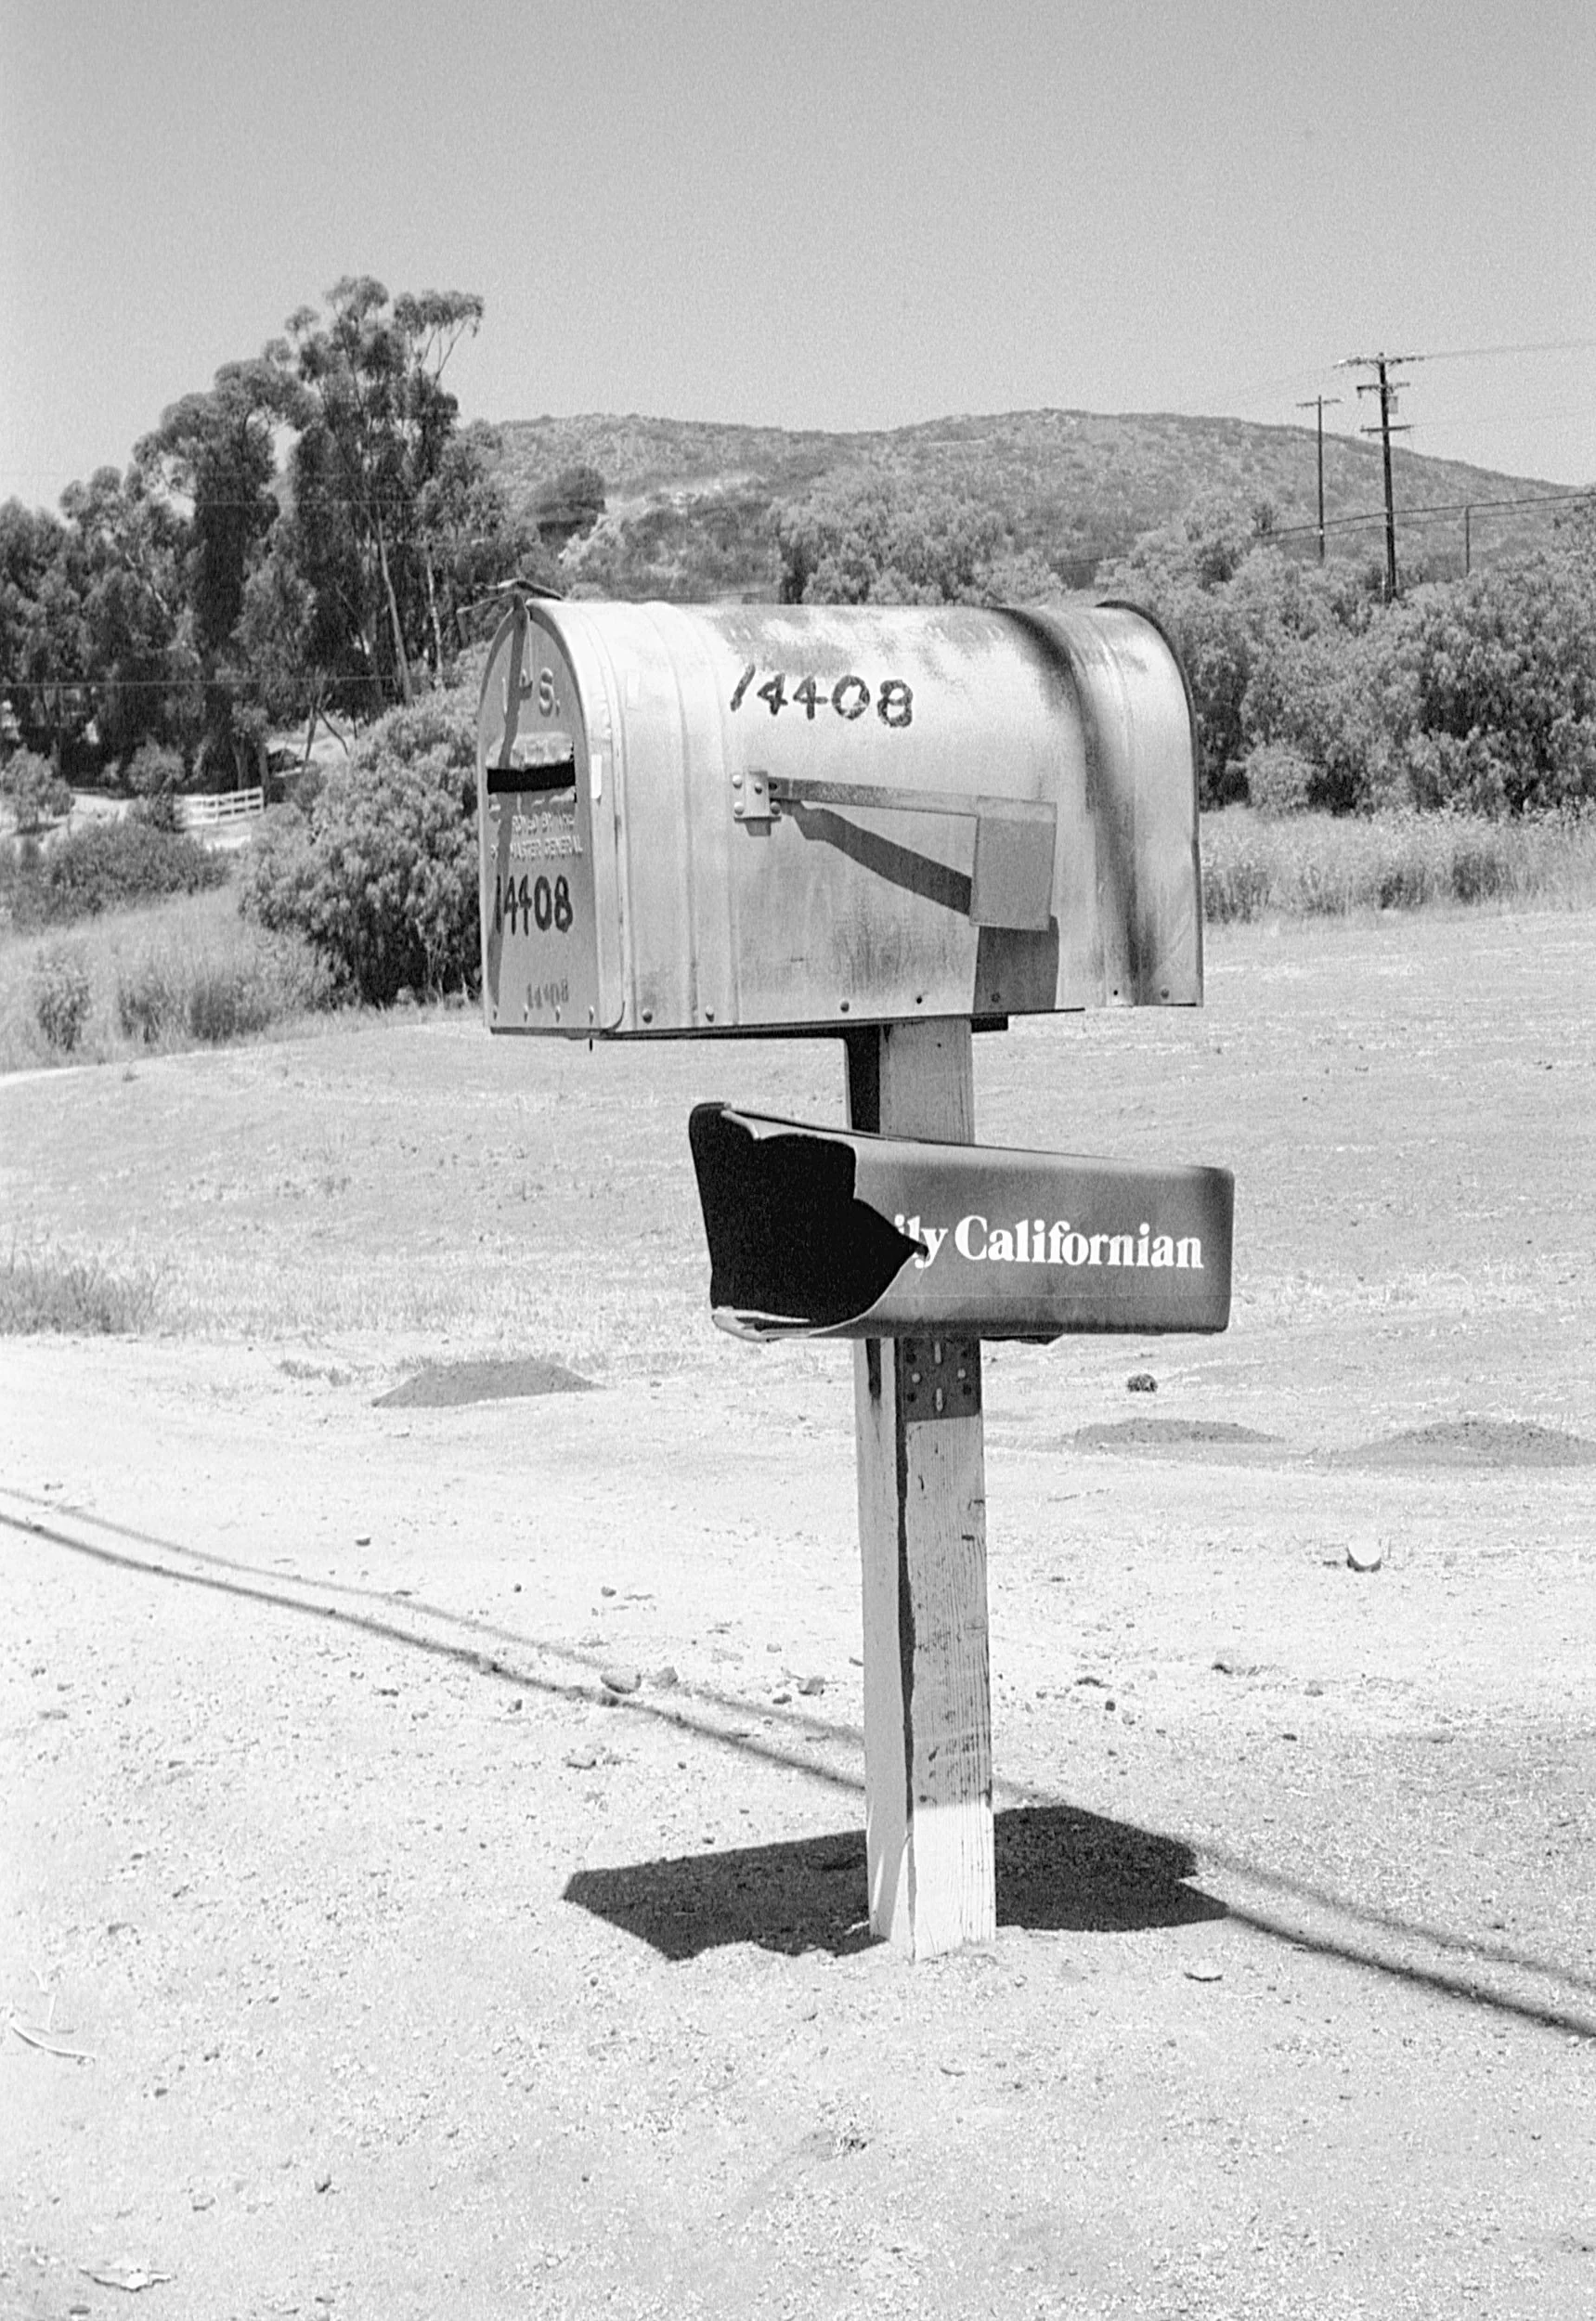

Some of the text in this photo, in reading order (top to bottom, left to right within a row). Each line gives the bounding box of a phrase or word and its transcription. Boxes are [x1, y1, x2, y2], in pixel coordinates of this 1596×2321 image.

[730, 664, 914, 728] 14408
[496, 874, 574, 937] 14408
[954, 1214, 1204, 1269] Californian
